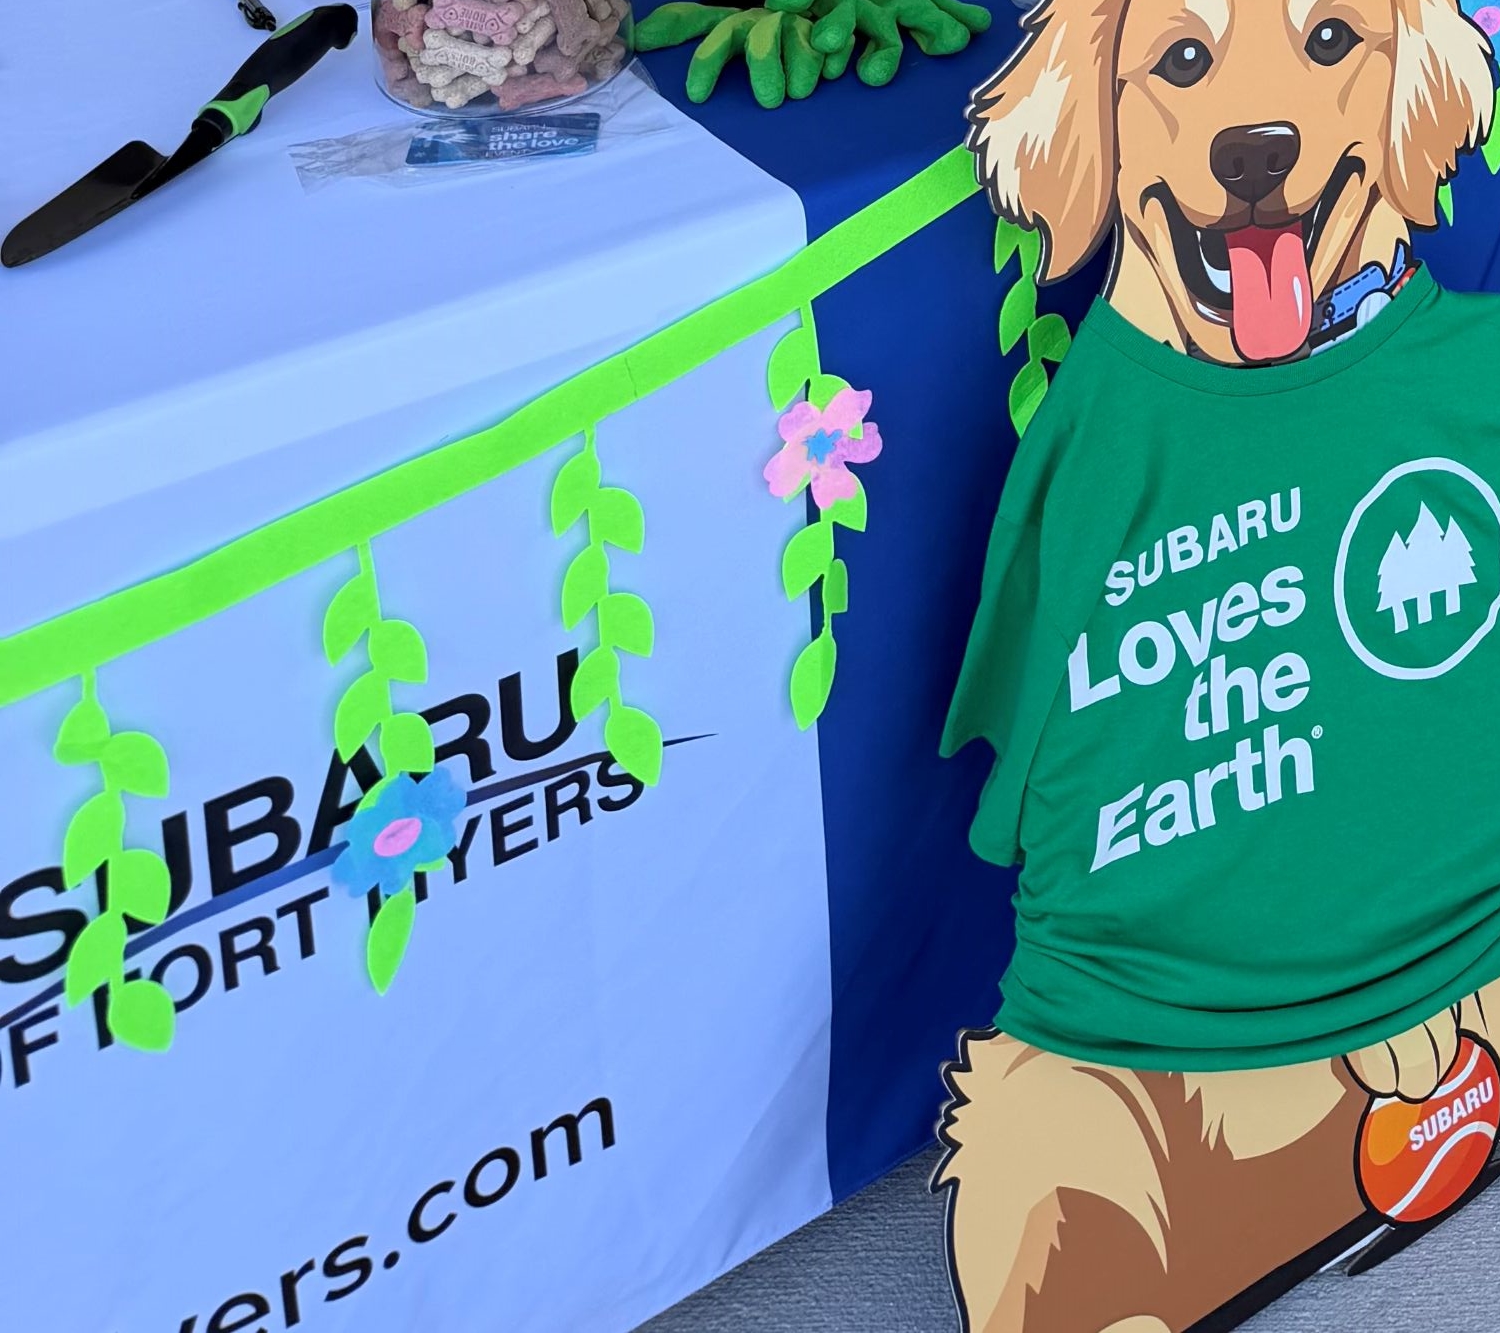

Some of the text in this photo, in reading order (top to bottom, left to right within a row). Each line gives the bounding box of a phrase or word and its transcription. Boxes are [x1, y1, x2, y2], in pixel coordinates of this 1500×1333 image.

[488, 137, 579, 151] the love
[489, 130, 558, 142] share
[1104, 486, 1302, 606] SUBARU
[1067, 565, 1306, 713] Loves
[1183, 652, 1311, 741] the
[366, 751, 646, 929] YERS
[1408, 1076, 1494, 1151] SUBARU
